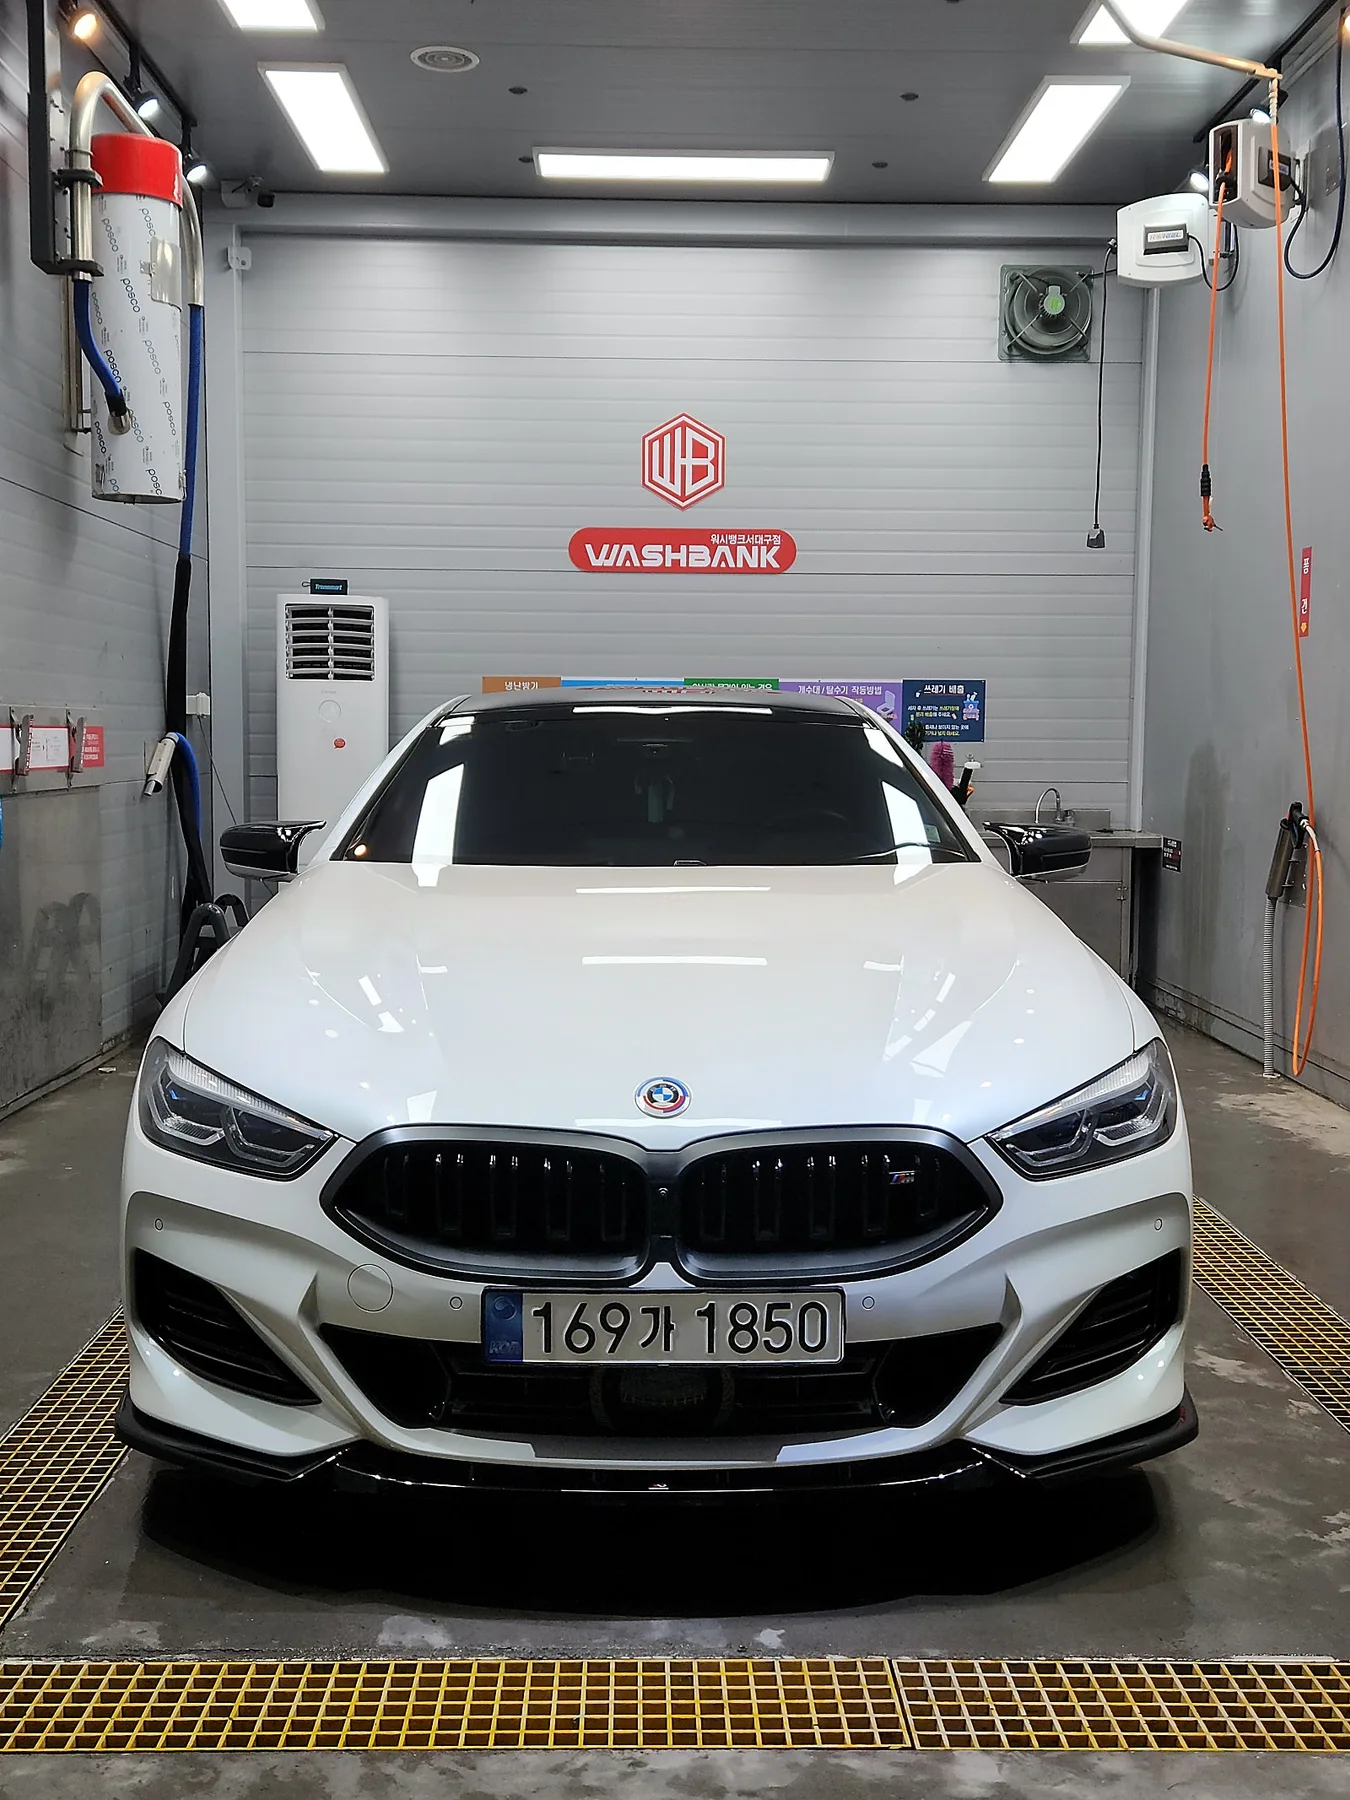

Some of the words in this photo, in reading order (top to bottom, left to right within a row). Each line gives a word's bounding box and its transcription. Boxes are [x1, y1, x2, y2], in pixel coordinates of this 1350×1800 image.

[101, 218, 119, 252] posco
[139, 208, 156, 236] posc
[120, 278, 140, 313] posco
[104, 349, 122, 383] posco
[142, 340, 161, 375] posco
[162, 401, 177, 436] posco
[94, 421, 107, 454] posco
[145, 468, 163, 495] posc
[710, 533, 782, 545] 워시뱅크서대구점
[584, 543, 781, 569] WASHBANK
[923, 684, 946, 694] 쓰레기
[948, 684, 965, 694] 배출
[532, 1301, 675, 1354] 169가
[696, 1301, 828, 1354] 1850
